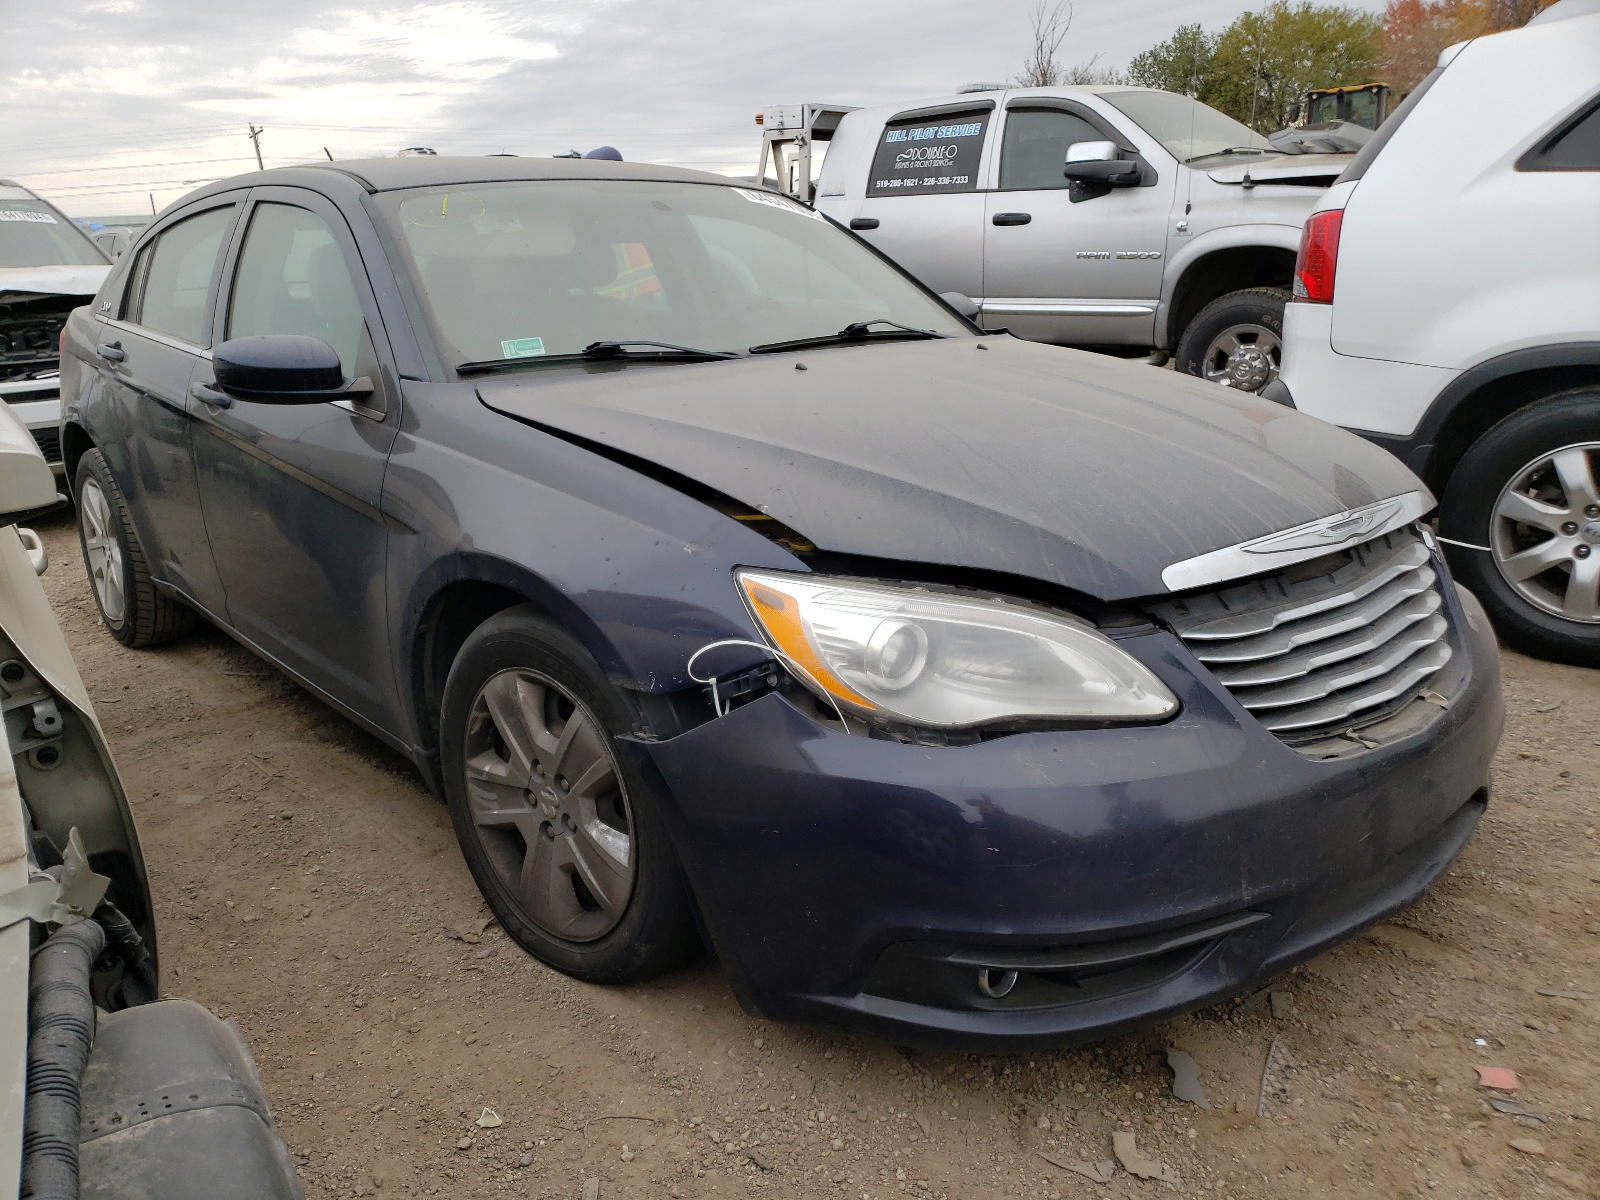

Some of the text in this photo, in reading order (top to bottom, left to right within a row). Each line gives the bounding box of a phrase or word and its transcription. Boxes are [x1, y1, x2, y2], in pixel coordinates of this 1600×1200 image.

[886, 123, 982, 142] HILL PILOT SERVICE
[1076, 251, 1161, 260] RAM 2500
